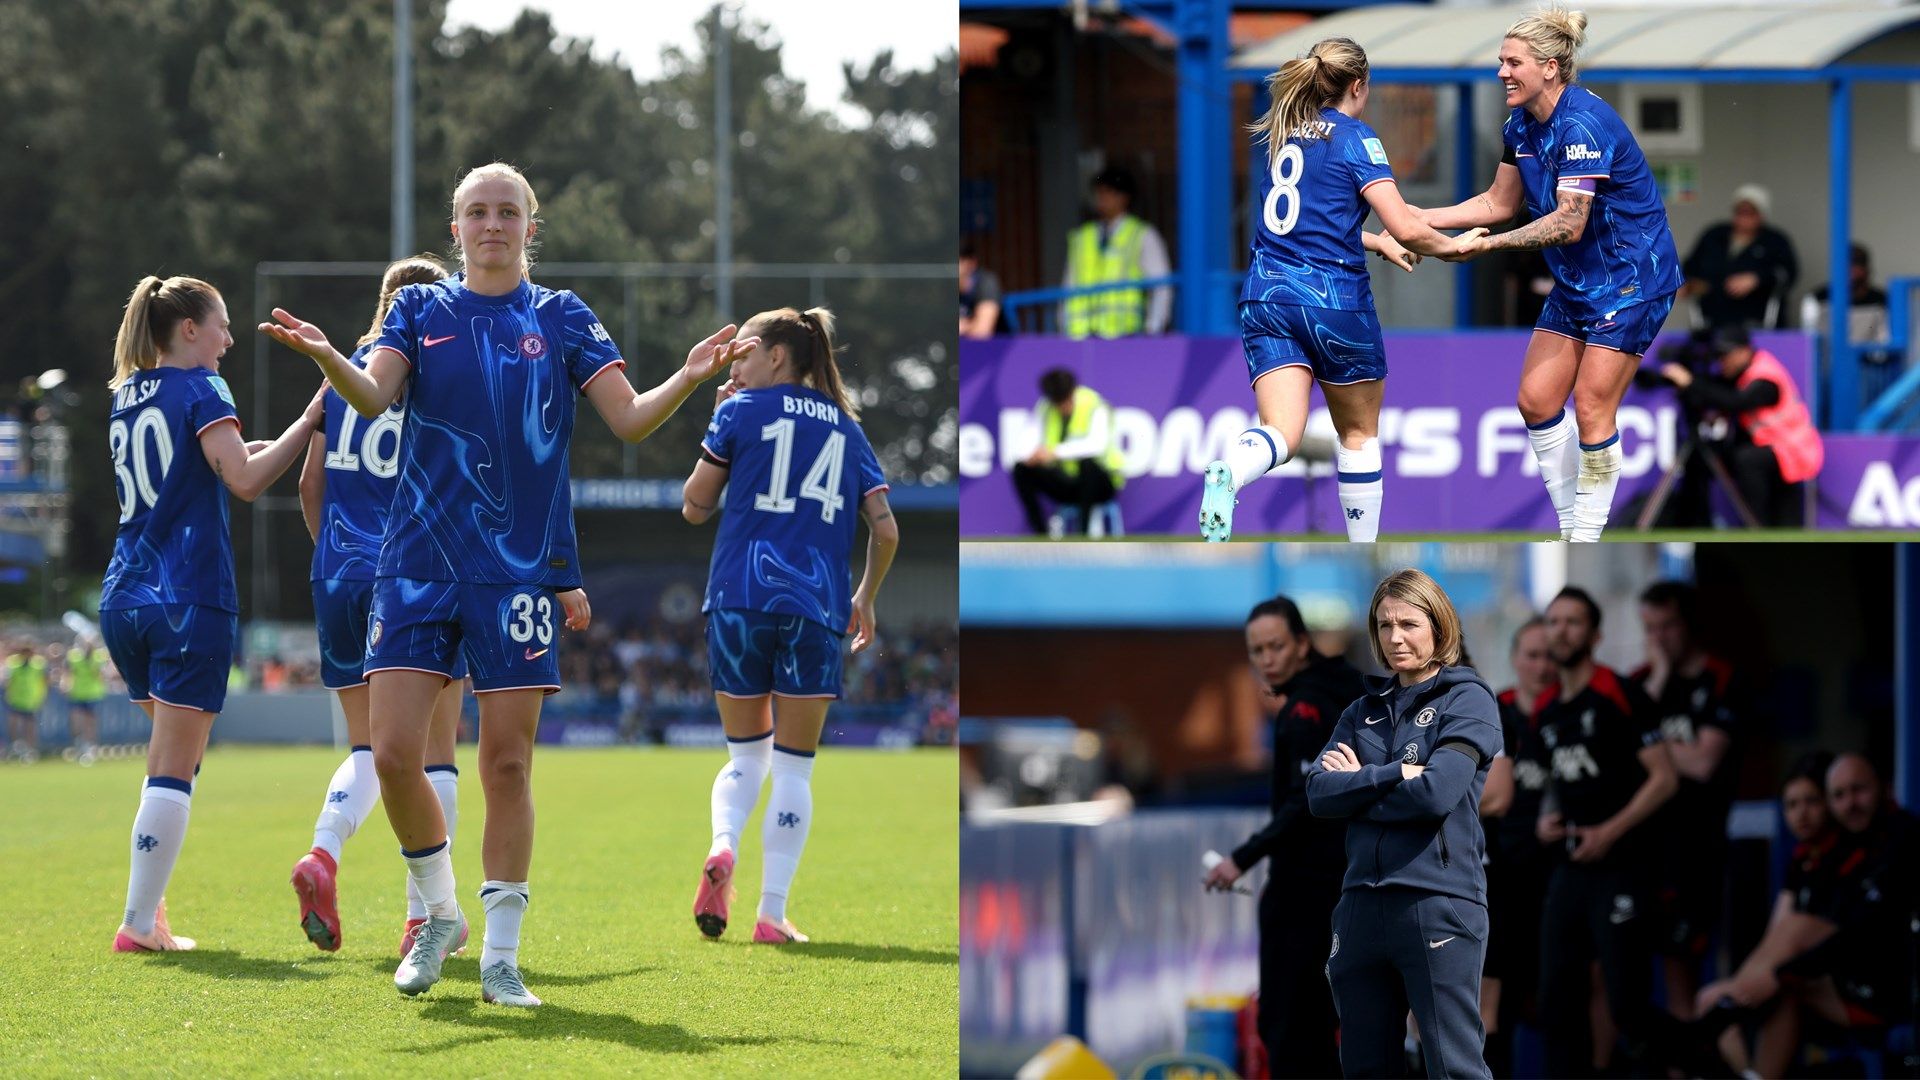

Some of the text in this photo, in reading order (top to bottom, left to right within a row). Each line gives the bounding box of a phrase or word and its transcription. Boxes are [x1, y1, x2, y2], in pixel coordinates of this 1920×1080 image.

[1565, 144, 1587, 153] LIVE
[1567, 150, 1602, 160] NATION
[1263, 143, 1304, 235] 8
[324, 402, 405, 478] 18
[783, 395, 839, 426] BJÖRN
[109, 407, 174, 524] 30
[754, 417, 846, 525] 14
[509, 593, 553, 645] 33
